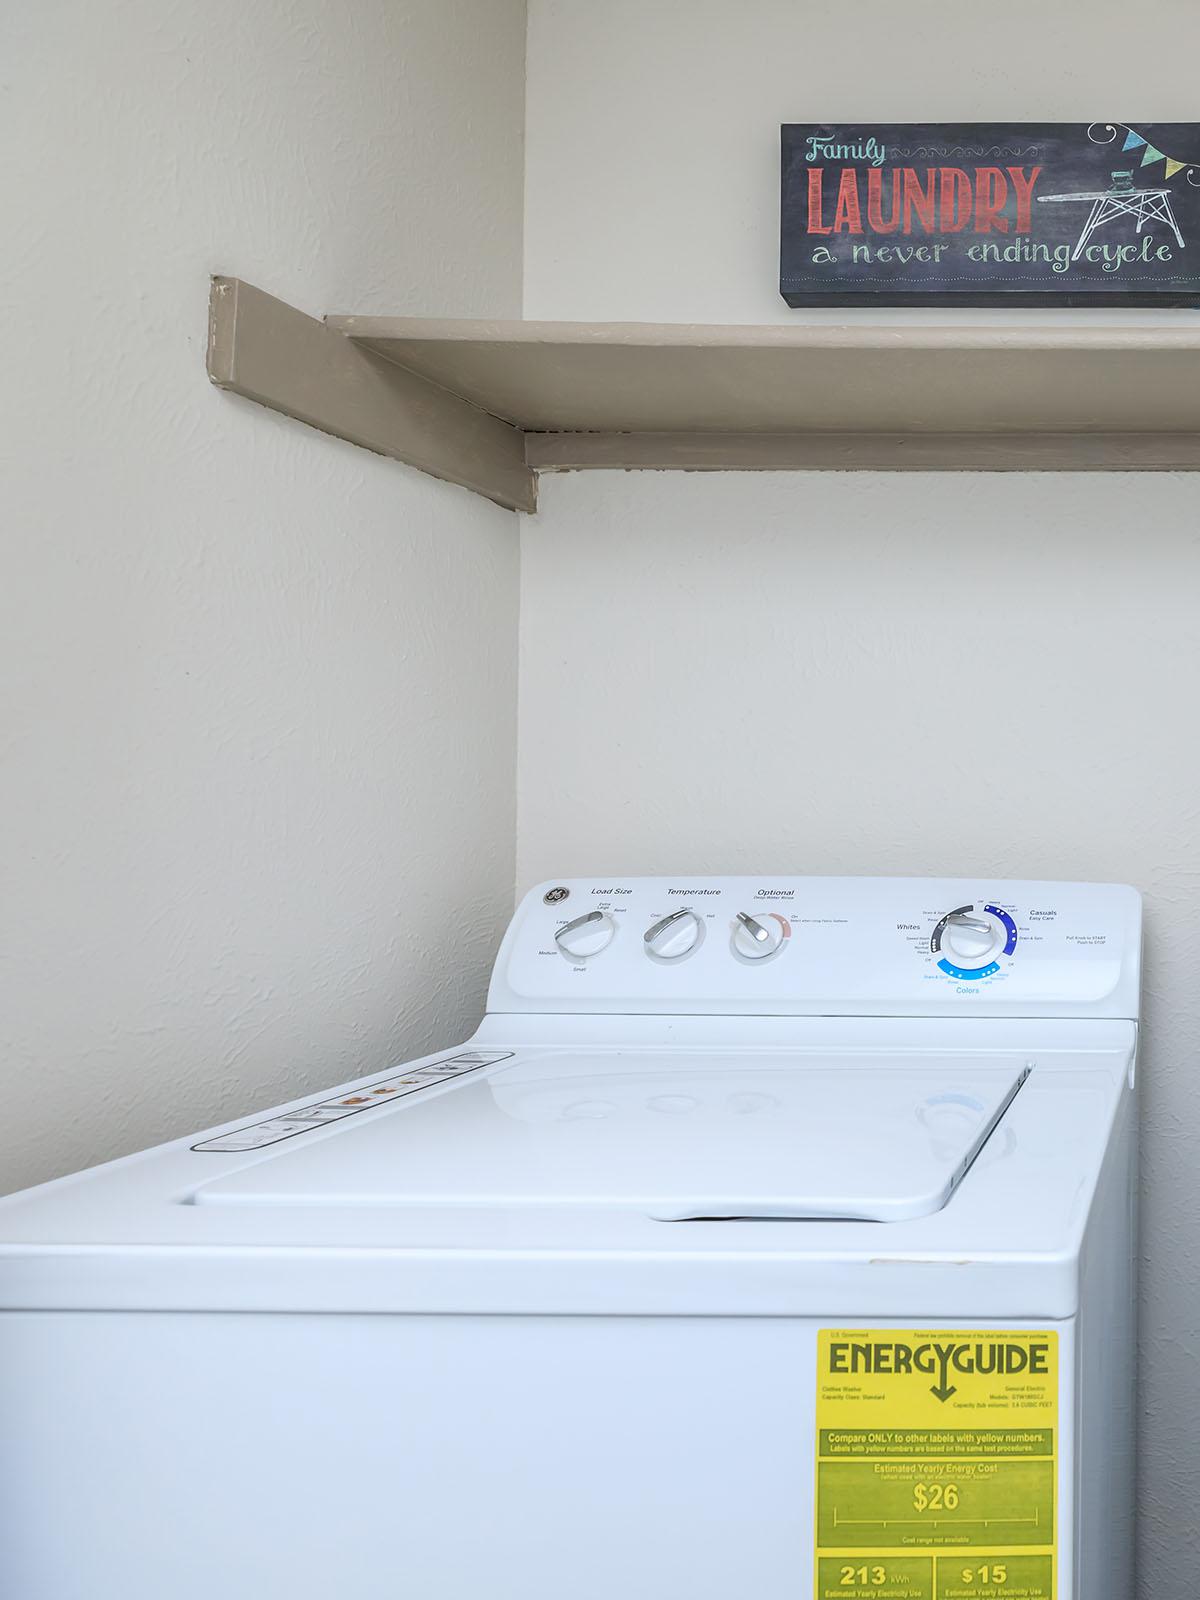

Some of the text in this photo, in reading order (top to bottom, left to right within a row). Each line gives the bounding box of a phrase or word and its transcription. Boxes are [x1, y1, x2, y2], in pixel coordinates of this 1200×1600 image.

[806, 134, 887, 167] Family
[807, 166, 1042, 235] LAUNDRY
[811, 235, 1173, 273] a never ending cycle
[667, 888, 722, 896] Temperature
[829, 1342, 1049, 1375] ENERGYGUIDE
[828, 1433, 1045, 1445] Compare ONLY to other labels with yellow numbers.
[865, 1445, 886, 1454] yellow
[874, 1464, 998, 1475] Estimated Yearly Energy Cost
[913, 1483, 959, 1513] $26
[902, 1536, 916, 1544] Cost
[916, 1537, 933, 1545] range
[840, 1566, 910, 1585] 213 kWh
[961, 1565, 1008, 1584] $ 15
[825, 1590, 922, 1599] Estimated Yearly Electricity Use
[944, 1589, 977, 1597] Estimated
[977, 1589, 997, 1598] Yearly
[1029, 1588, 1042, 1596] Use
